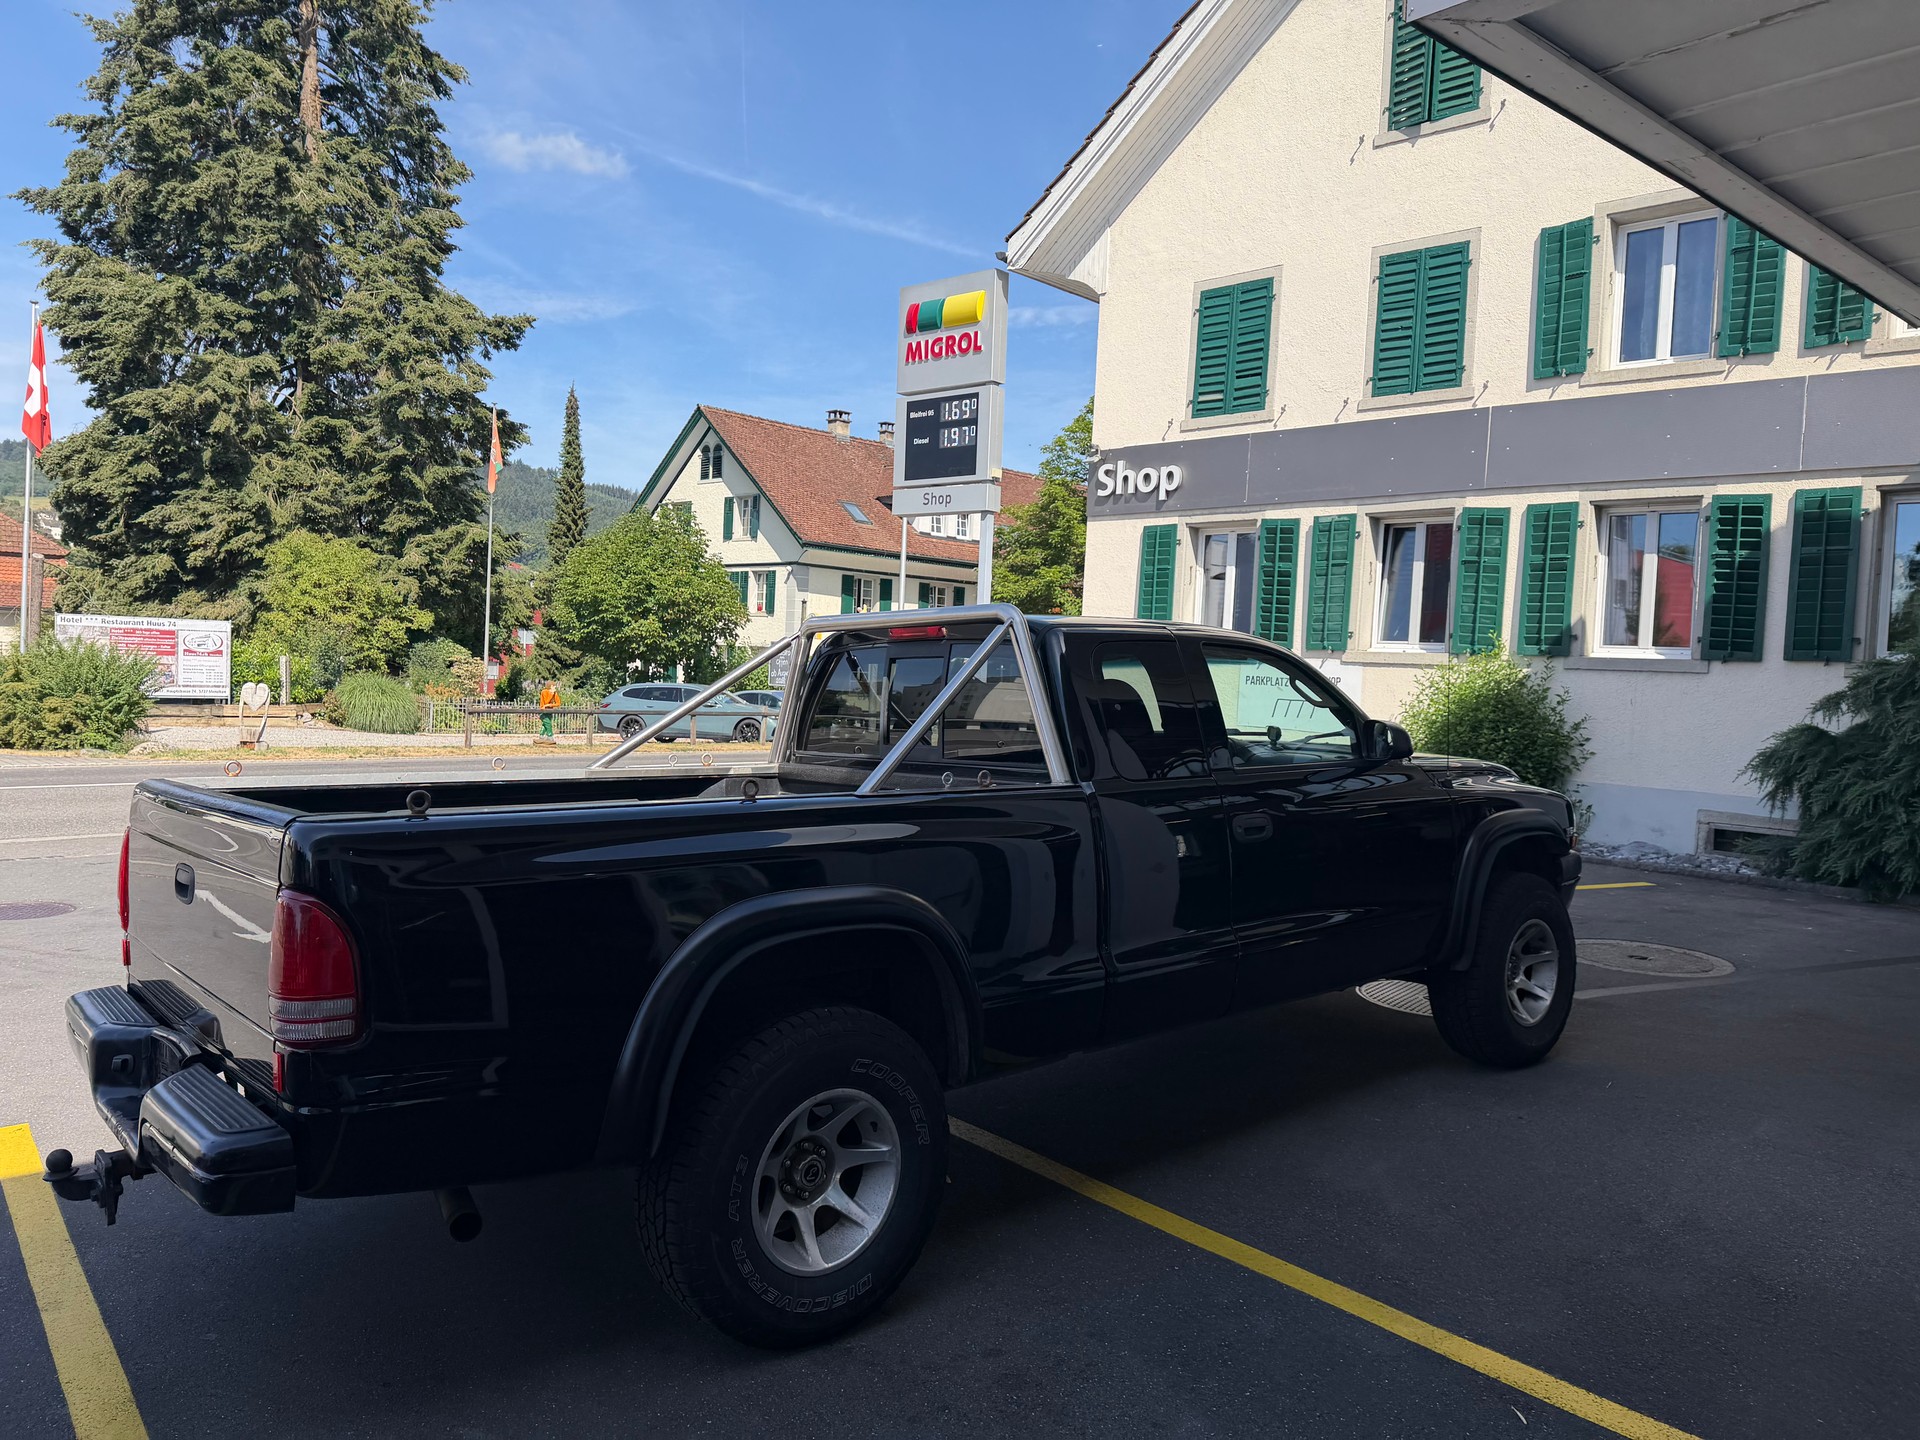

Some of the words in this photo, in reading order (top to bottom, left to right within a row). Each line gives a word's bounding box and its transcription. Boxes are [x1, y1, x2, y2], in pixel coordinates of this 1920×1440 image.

[905, 330, 982, 363] MIGROL
[909, 410, 928, 419] Bleifrei
[927, 409, 935, 417] 95
[913, 437, 930, 445] Diesel
[1096, 460, 1183, 501] Shop
[922, 492, 952, 507] Shop
[60, 616, 83, 624] Hotel
[101, 618, 145, 627] Restaurant
[1245, 675, 1290, 687] PARKPLATZ
[850, 1057, 931, 1146] COOPER
[728, 1153, 750, 1222] AT3
[730, 1237, 874, 1314] DISCOVERER
